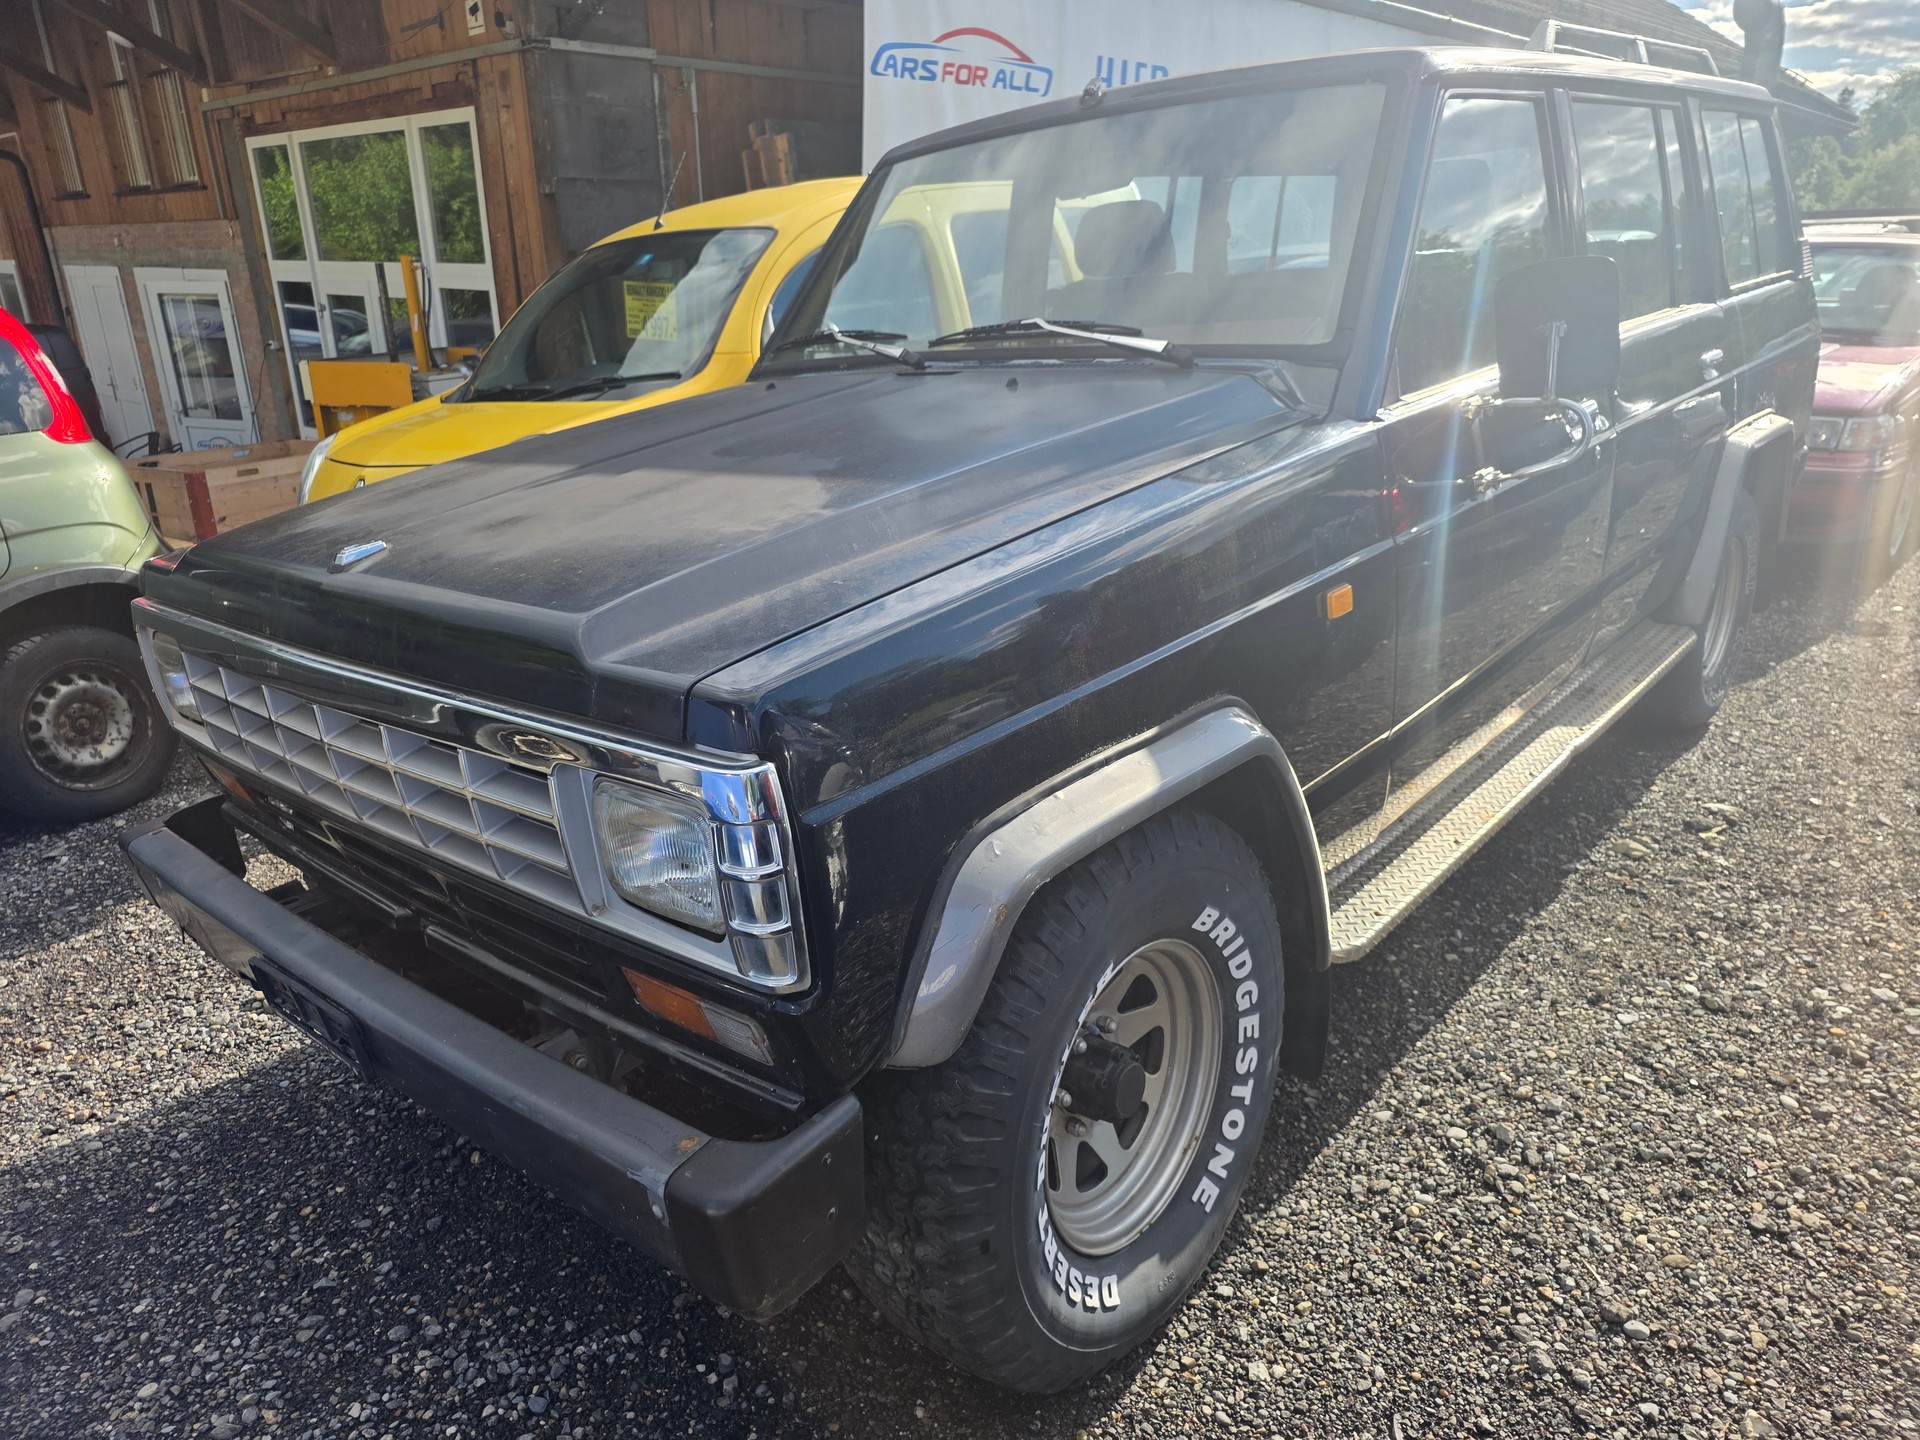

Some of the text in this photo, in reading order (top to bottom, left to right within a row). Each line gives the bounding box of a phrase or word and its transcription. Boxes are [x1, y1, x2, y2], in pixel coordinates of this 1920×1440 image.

[941, 62, 989, 87] FOR
[992, 69, 1040, 93] ALL
[1191, 906, 1260, 1213] BRIDGESTONE
[1038, 1202, 1121, 1308] DESERT
